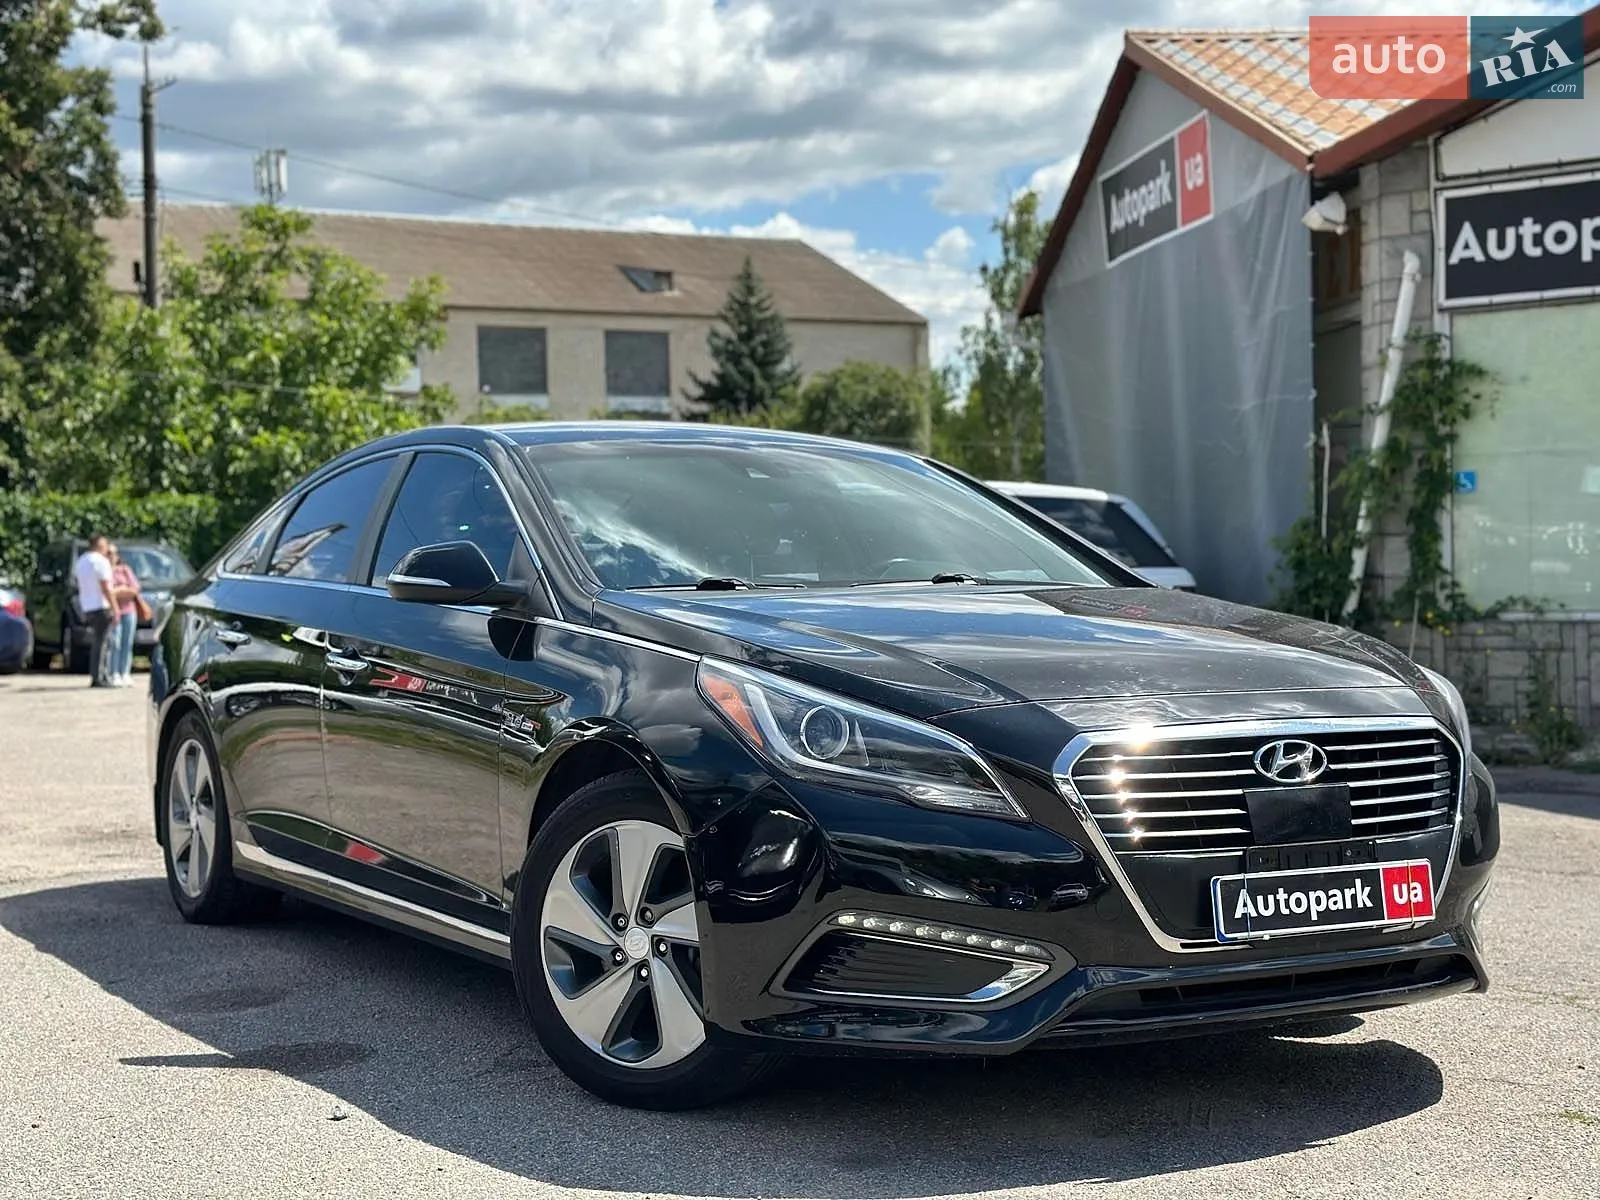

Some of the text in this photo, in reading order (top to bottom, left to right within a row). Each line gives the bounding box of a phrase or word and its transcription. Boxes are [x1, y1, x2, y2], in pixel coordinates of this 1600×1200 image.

[1110, 152, 1205, 235] Autopark ua
[1234, 878, 1424, 921] Autopark ua
